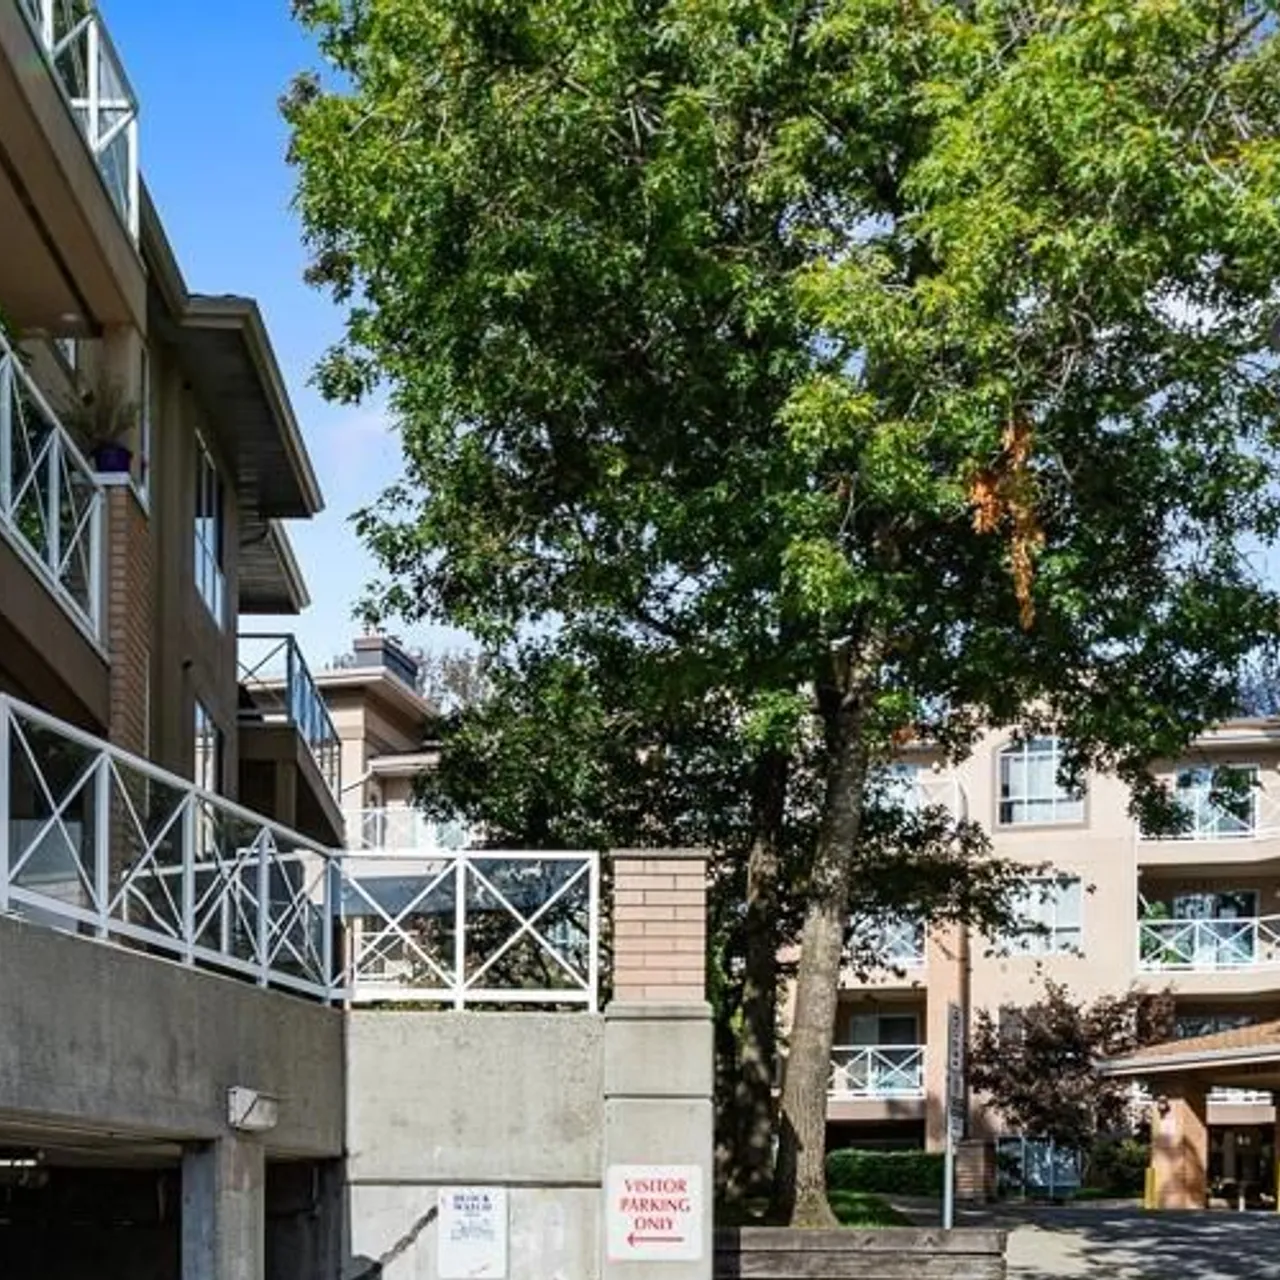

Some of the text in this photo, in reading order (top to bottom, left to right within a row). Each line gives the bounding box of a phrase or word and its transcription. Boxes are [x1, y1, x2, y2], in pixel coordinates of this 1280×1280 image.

[624, 1178, 687, 1194] VISITOR
[620, 1197, 691, 1213] PARKING
[634, 1216, 673, 1231] ONLY
